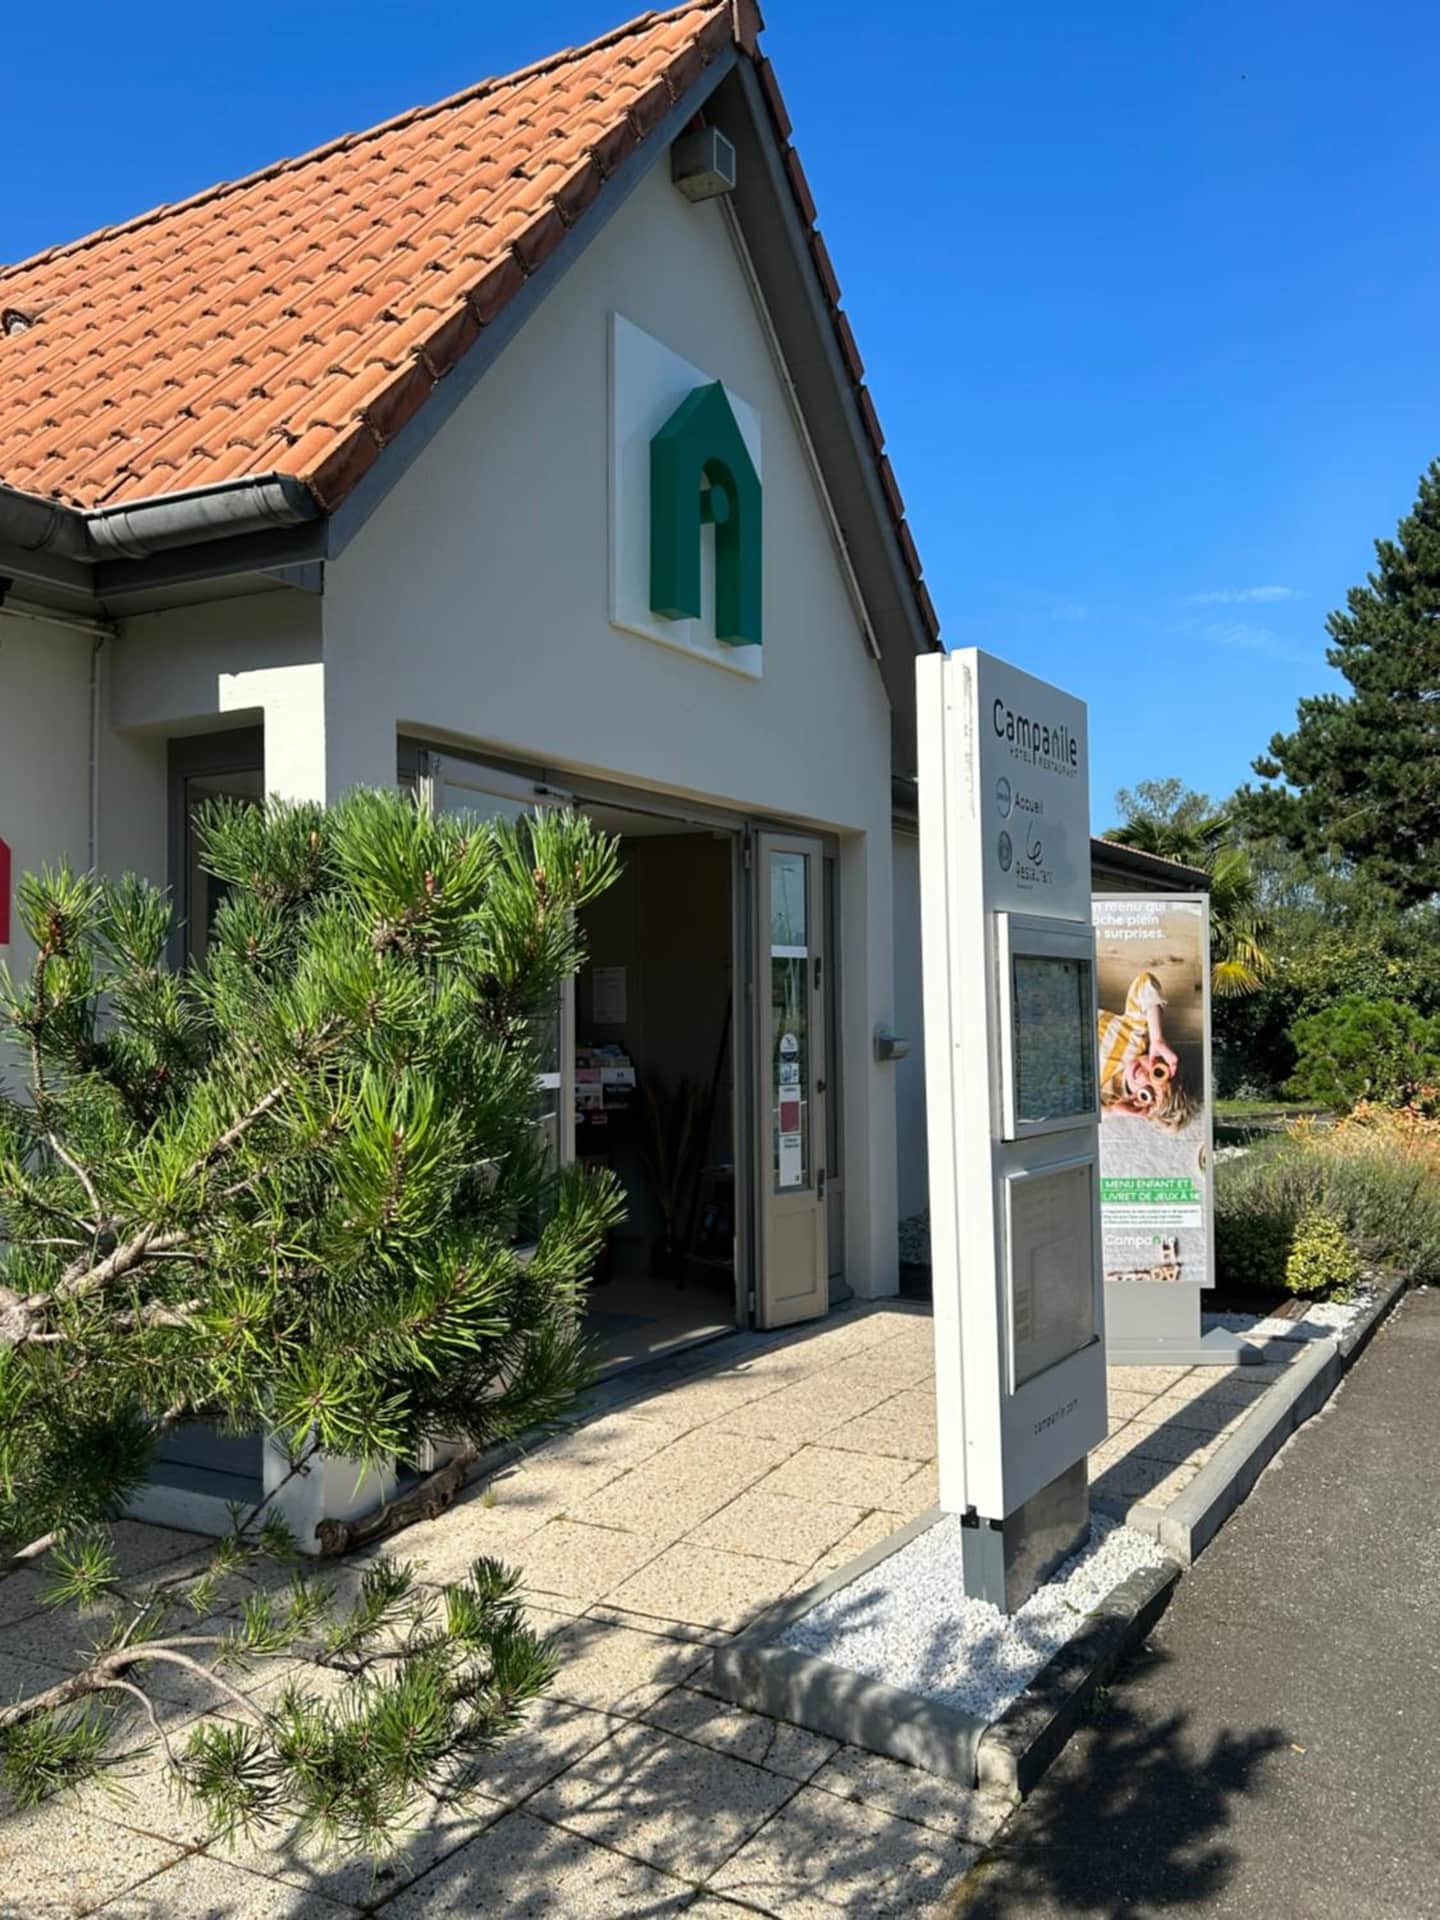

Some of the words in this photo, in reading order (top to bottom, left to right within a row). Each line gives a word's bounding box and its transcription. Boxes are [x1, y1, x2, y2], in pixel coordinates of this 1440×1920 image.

[993, 698, 1077, 766] Campanile
[1015, 792, 1043, 815] Accueil
[1104, 902, 1141, 912] menu
[1146, 902, 1167, 915] qui
[1127, 912, 1159, 927] plein
[1105, 1180, 1134, 1189] MENU
[1136, 1180, 1173, 1189] ENFANT
[1177, 1180, 1190, 1189] ET
[1103, 1192, 1137, 1201] LIVRET
[1138, 1192, 1150, 1201] DE
[1155, 1192, 1179, 1201] JEUX
